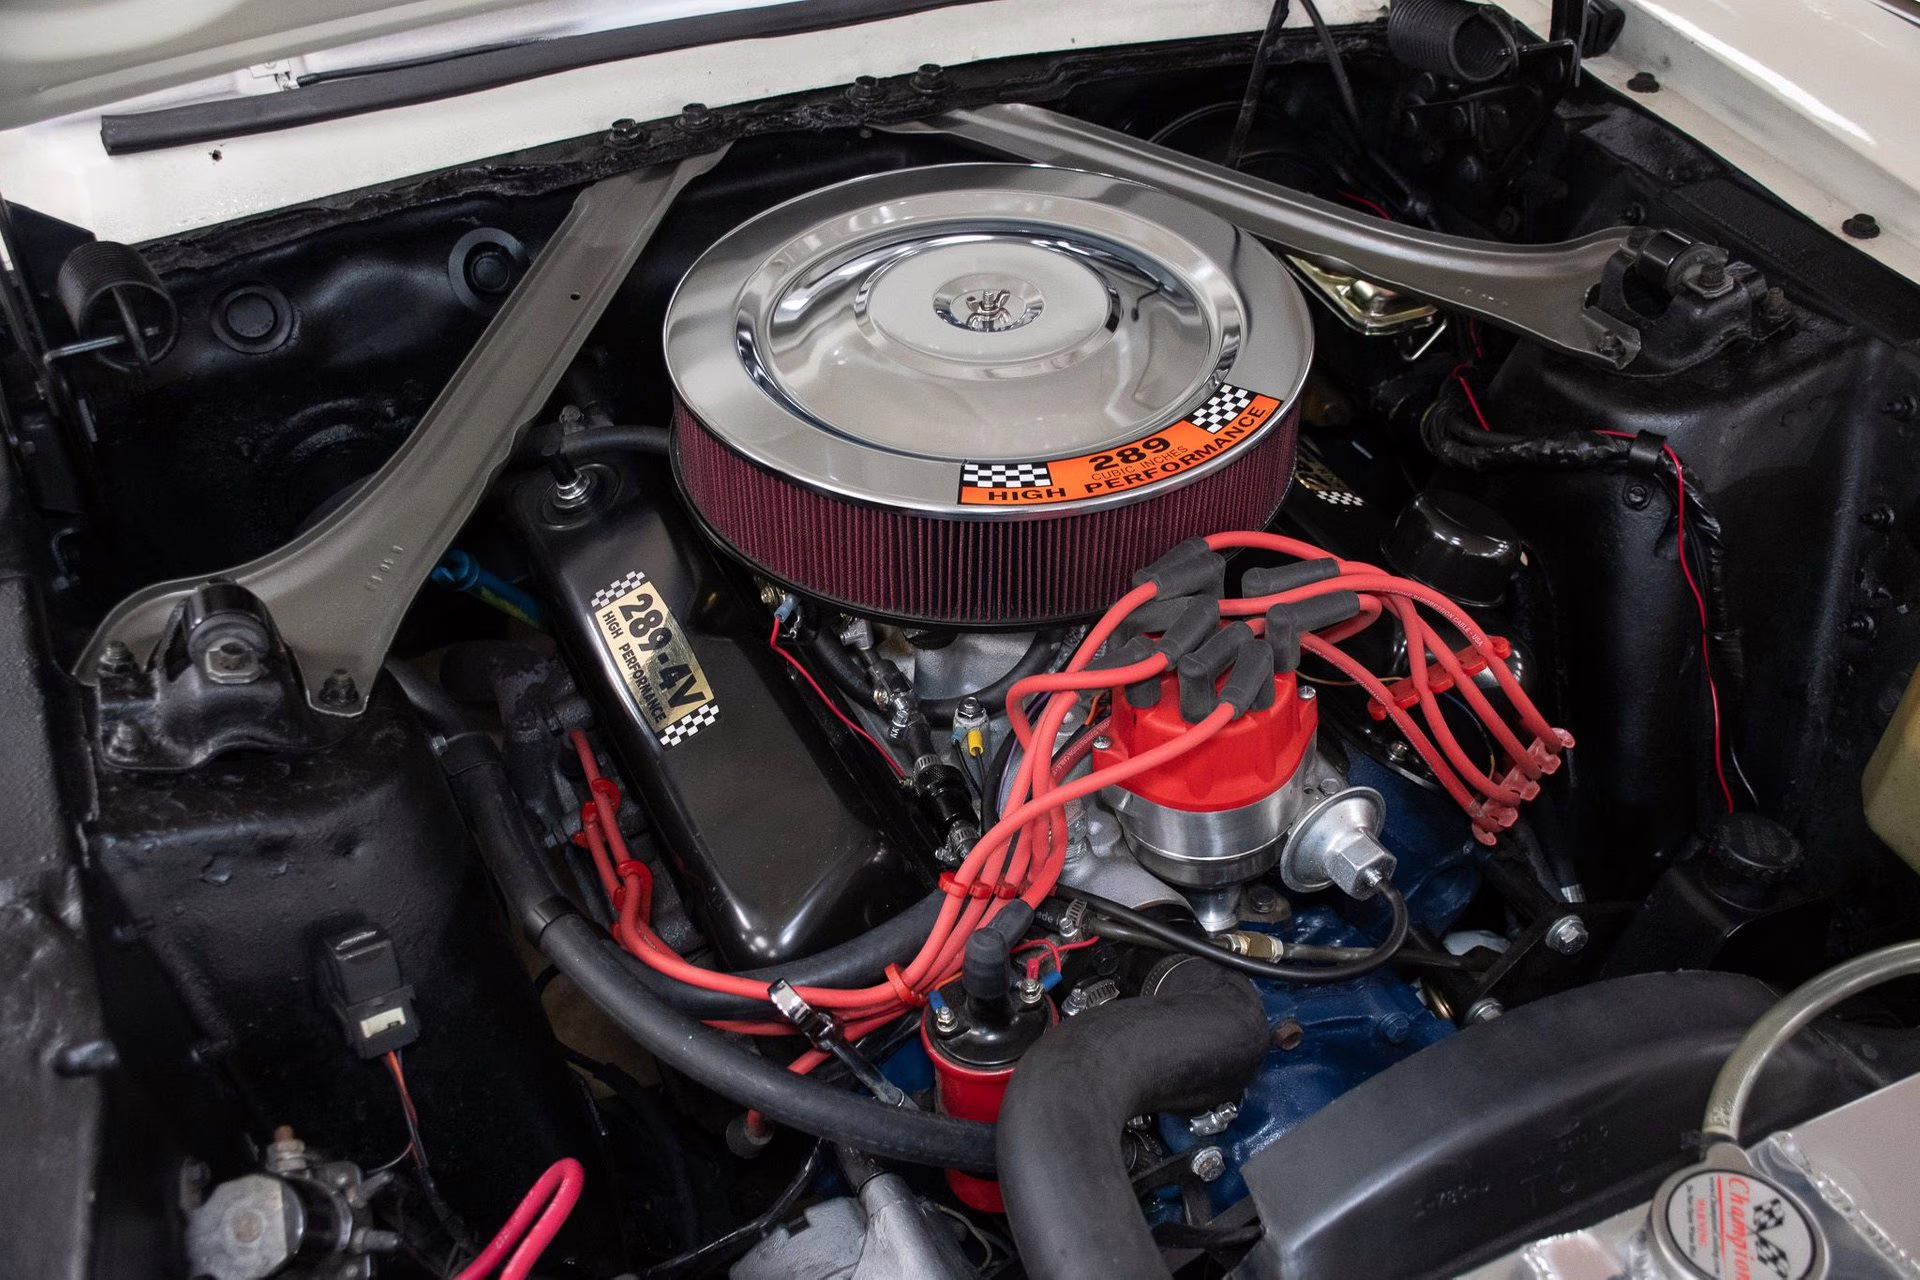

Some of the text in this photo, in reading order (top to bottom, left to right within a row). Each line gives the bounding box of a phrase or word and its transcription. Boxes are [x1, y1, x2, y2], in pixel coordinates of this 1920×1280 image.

[988, 487, 1066, 501] HIGH
[1085, 406, 1266, 493] PERFORMANCE
[1089, 438, 1170, 472] 289
[1092, 446, 1188, 481] CUBIC INCHES
[1452, 615, 1471, 634] CABLE
[1471, 634, 1485, 647] USA
[602, 611, 667, 724] HIGH PERFORMANCE
[1726, 1178, 1755, 1280] Champion
